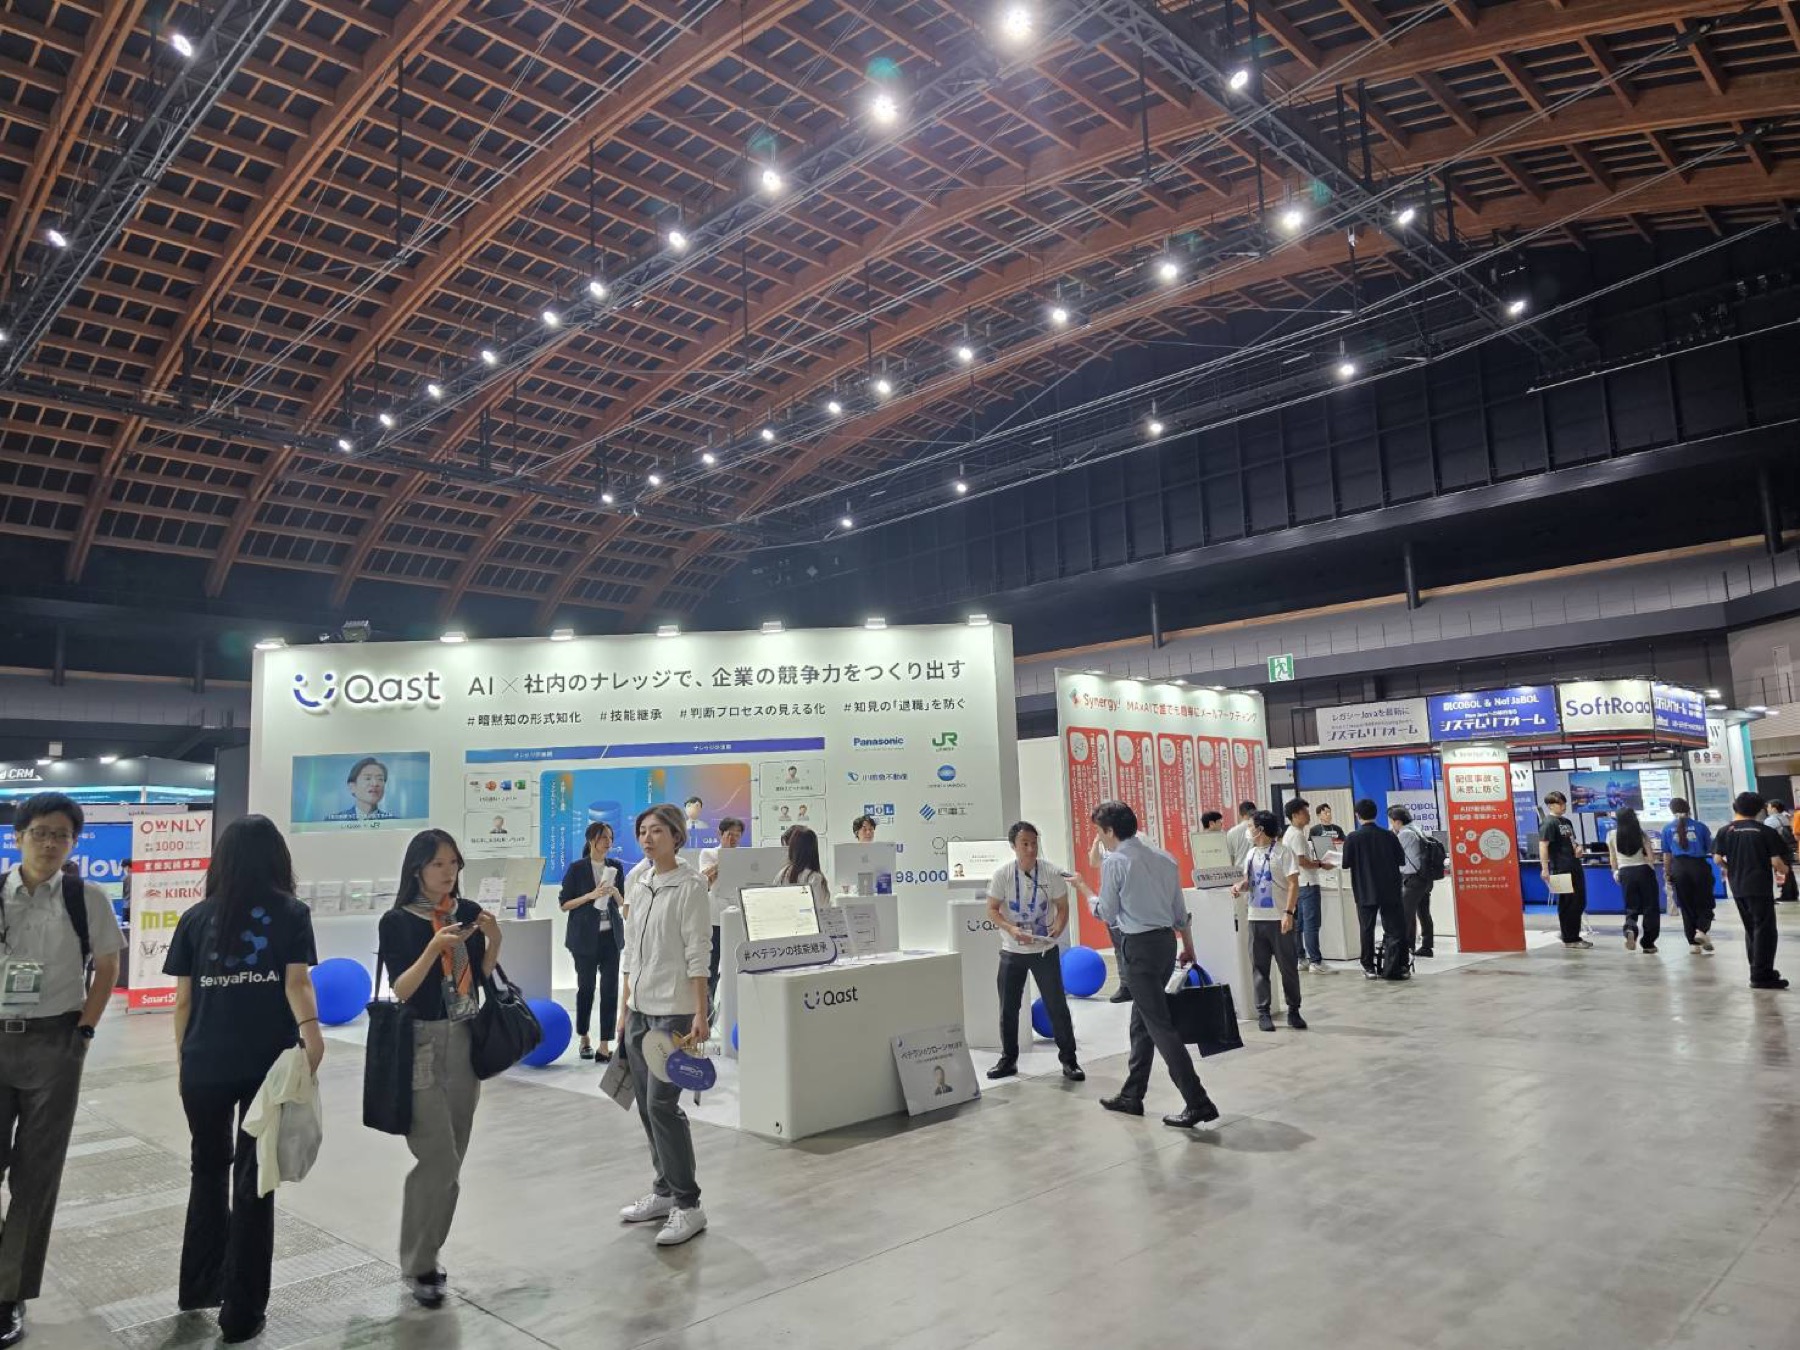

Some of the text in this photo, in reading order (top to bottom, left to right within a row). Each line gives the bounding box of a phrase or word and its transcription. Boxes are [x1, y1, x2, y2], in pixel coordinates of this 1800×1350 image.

[344, 671, 441, 703] Qast
[853, 736, 904, 747] Panasonic
[932, 732, 958, 746] JR
[9, 769, 34, 778] CRM
[864, 804, 894, 815] MOL
[140, 819, 206, 834] OWNLY
[156, 840, 183, 851] 1000
[165, 887, 202, 898] KIRIN
[824, 986, 859, 1006] Qast
